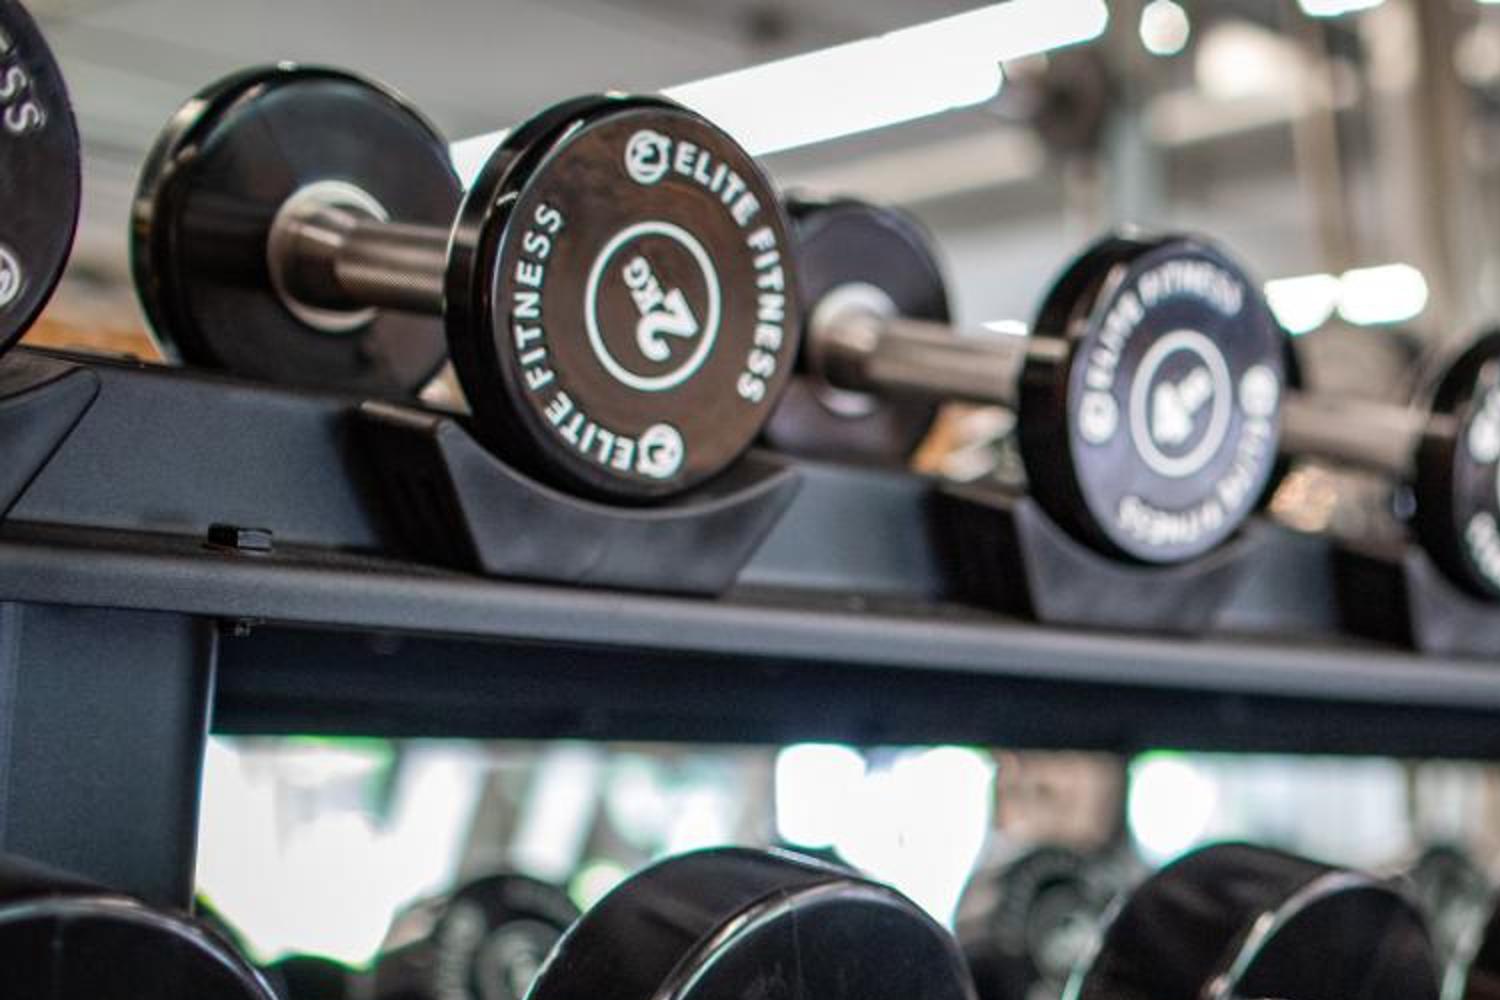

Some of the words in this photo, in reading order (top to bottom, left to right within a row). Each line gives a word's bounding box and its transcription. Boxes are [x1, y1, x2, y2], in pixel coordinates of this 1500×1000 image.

[513, 204, 564, 390] FITNESS
[674, 141, 761, 227] ELITE
[737, 227, 785, 403] FITNESS
[544, 391, 636, 472] ELITE
